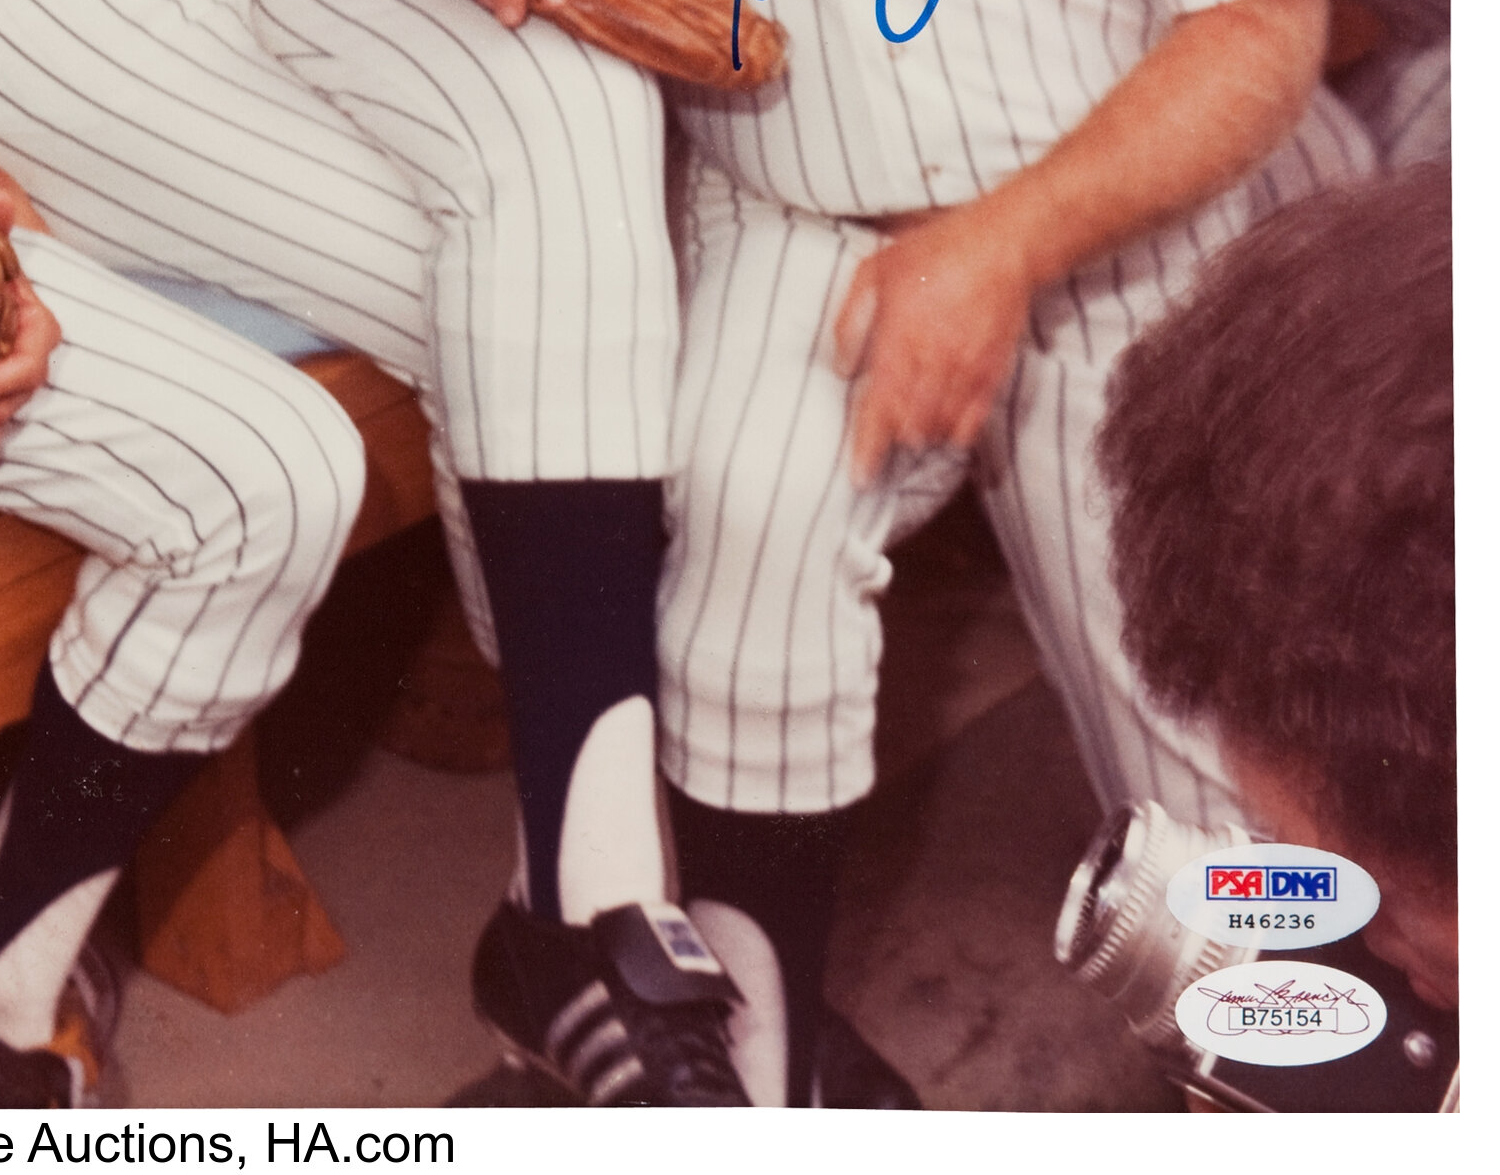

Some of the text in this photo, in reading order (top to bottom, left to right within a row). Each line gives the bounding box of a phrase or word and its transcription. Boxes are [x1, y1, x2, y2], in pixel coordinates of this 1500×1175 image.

[1211, 870, 1331, 899] PSA DNA
[1228, 913, 1316, 930] H46236
[1242, 1007, 1323, 1027] B75154
